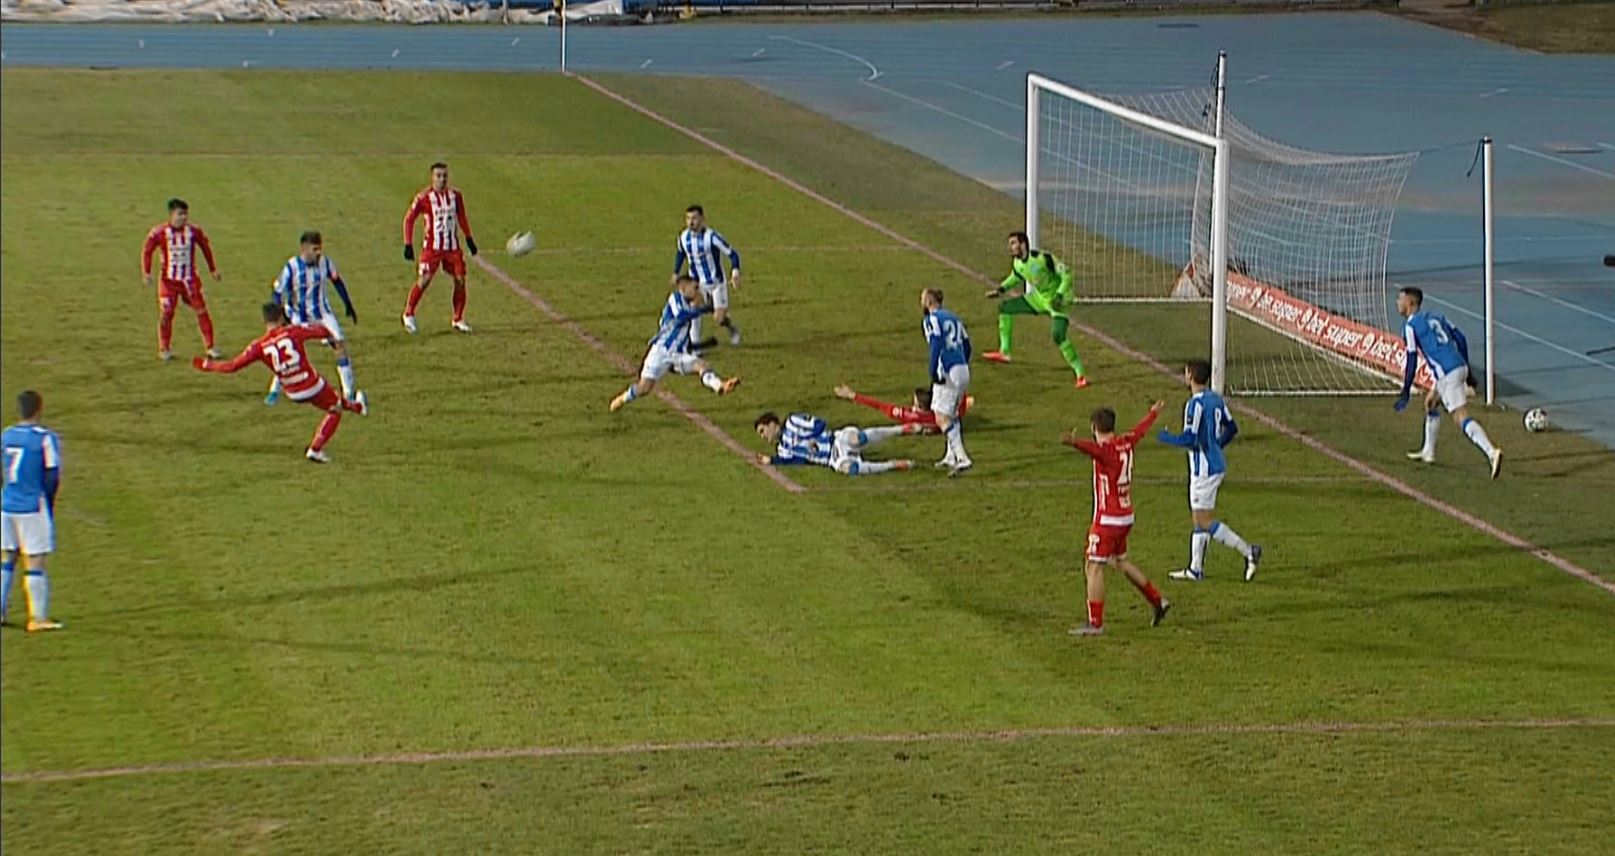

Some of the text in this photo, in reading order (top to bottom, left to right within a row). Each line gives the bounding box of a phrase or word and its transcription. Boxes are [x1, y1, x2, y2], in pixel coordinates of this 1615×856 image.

[1306, 311, 1329, 335] bet
[1323, 324, 1363, 348] super
[1372, 335, 1397, 361] bet
[1428, 318, 1449, 344] 3
[263, 337, 300, 372] 23
[6, 447, 25, 484] 7
